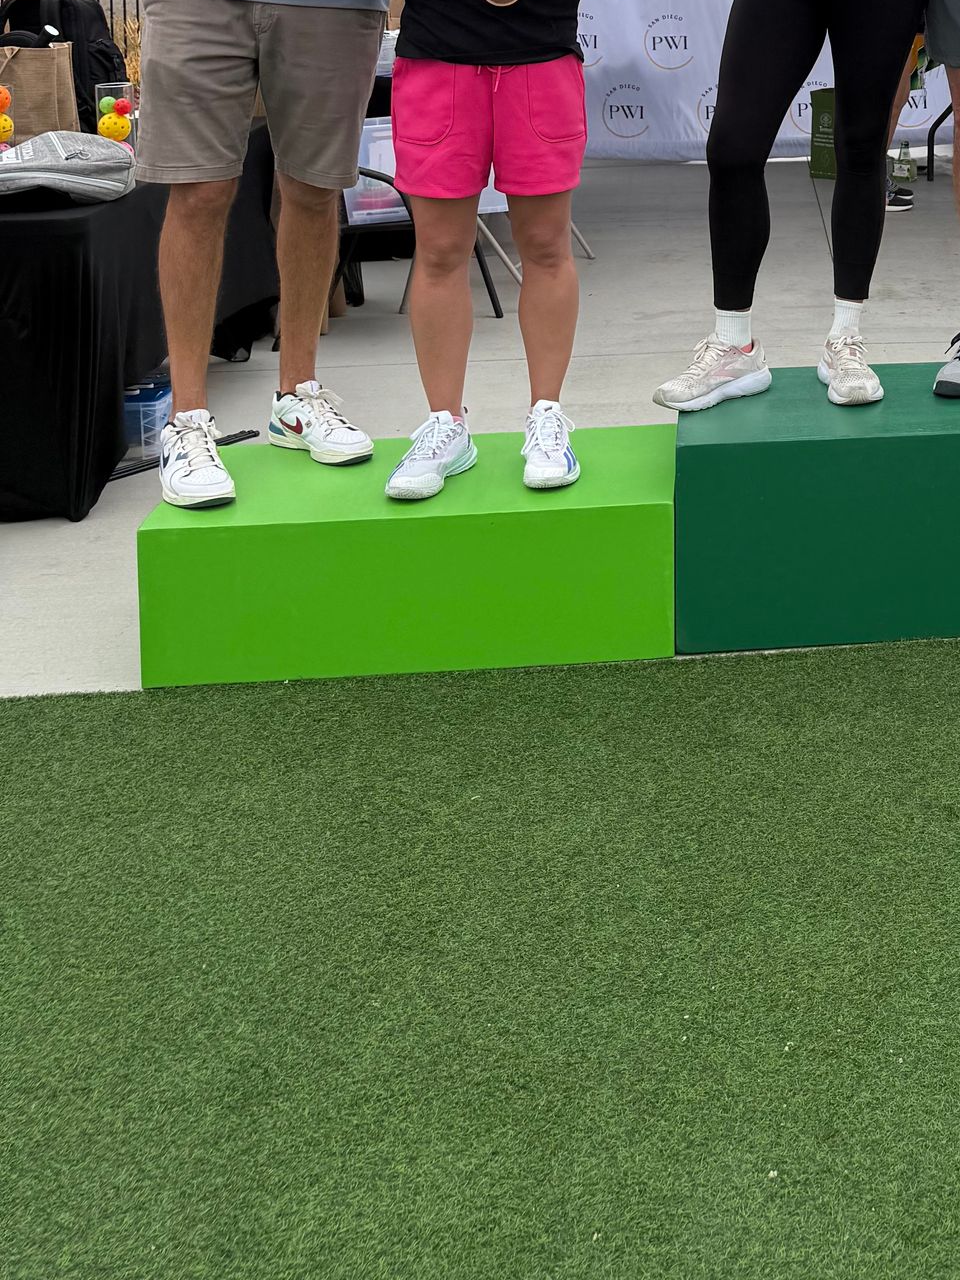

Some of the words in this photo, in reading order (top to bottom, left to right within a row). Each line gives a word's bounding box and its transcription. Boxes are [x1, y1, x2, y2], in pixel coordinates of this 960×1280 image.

[648, 17, 659, 28] SAN
[578, 34, 598, 49] WI
[652, 35, 688, 50] PWI
[605, 87, 617, 97] SAN
[619, 84, 640, 92] DIEGO
[701, 87, 713, 97] SAN
[907, 96, 927, 109] WI
[609, 104, 644, 120] PWI
